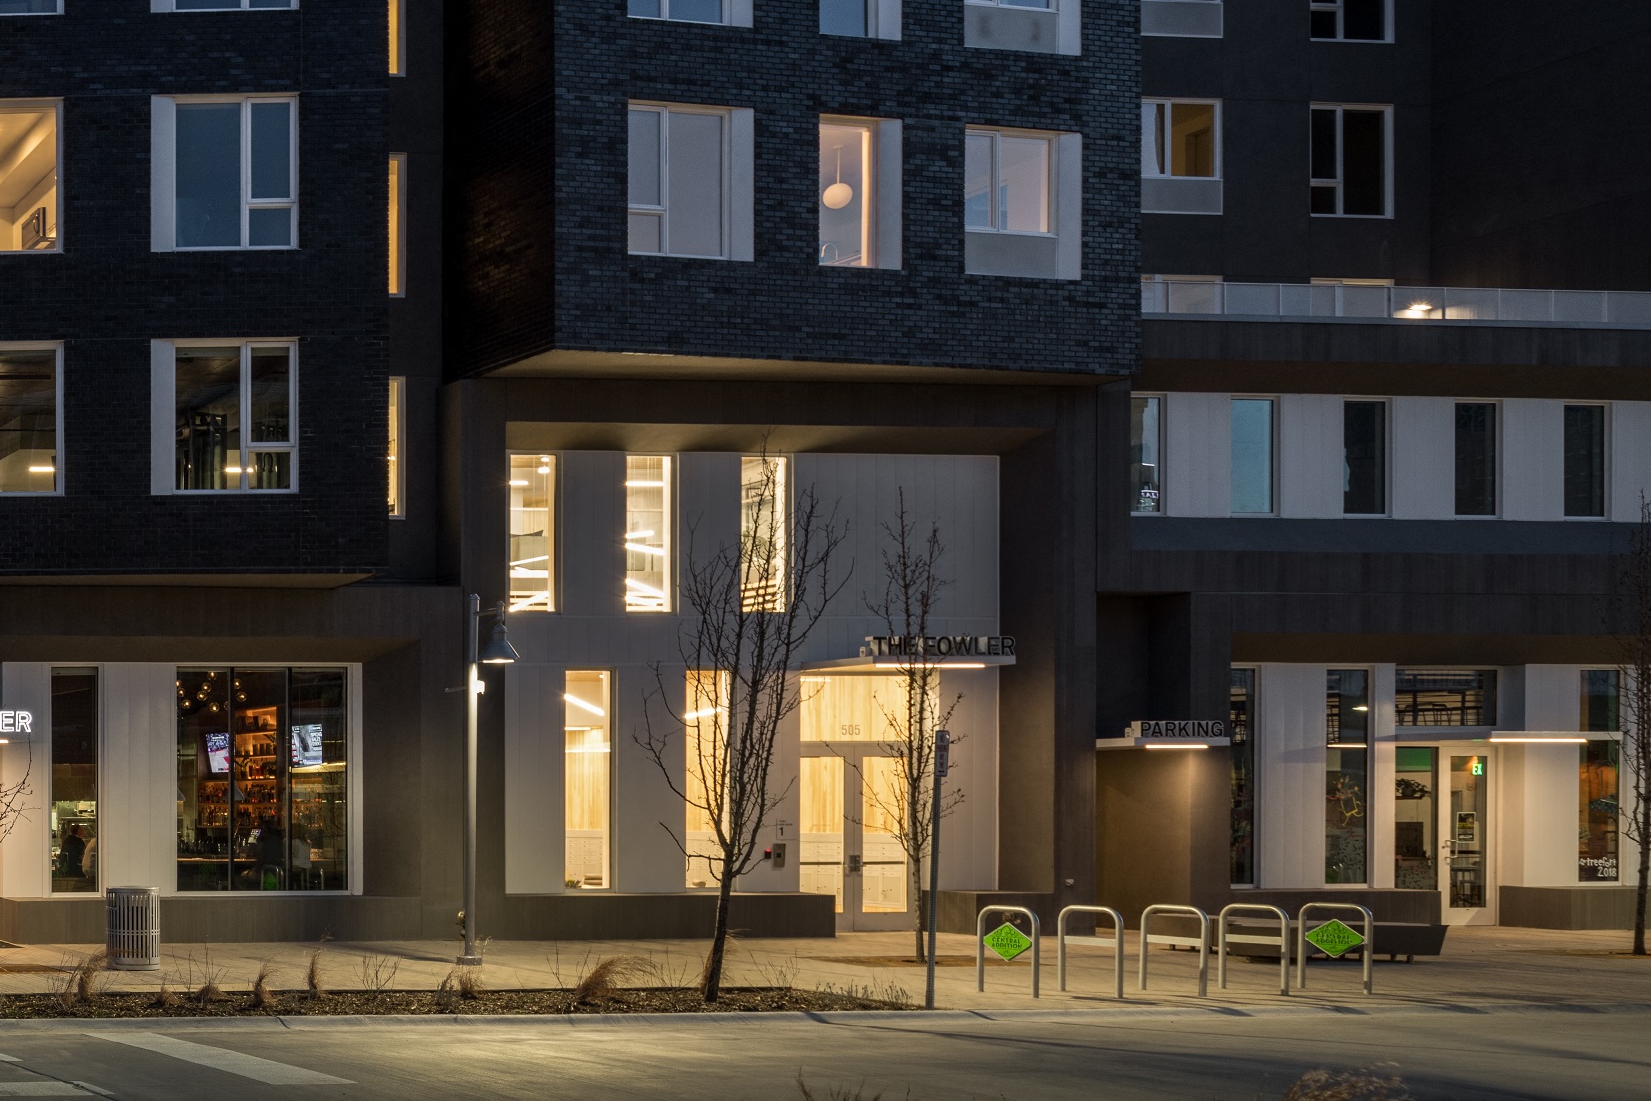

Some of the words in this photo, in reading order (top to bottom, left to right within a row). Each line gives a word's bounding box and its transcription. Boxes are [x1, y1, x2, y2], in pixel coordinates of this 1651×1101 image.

[873, 636, 917, 656] THE
[923, 636, 1016, 656] FOWLER
[841, 724, 861, 736] 505
[1140, 721, 1224, 738] PARKING
[1597, 866, 1617, 877] 2018
